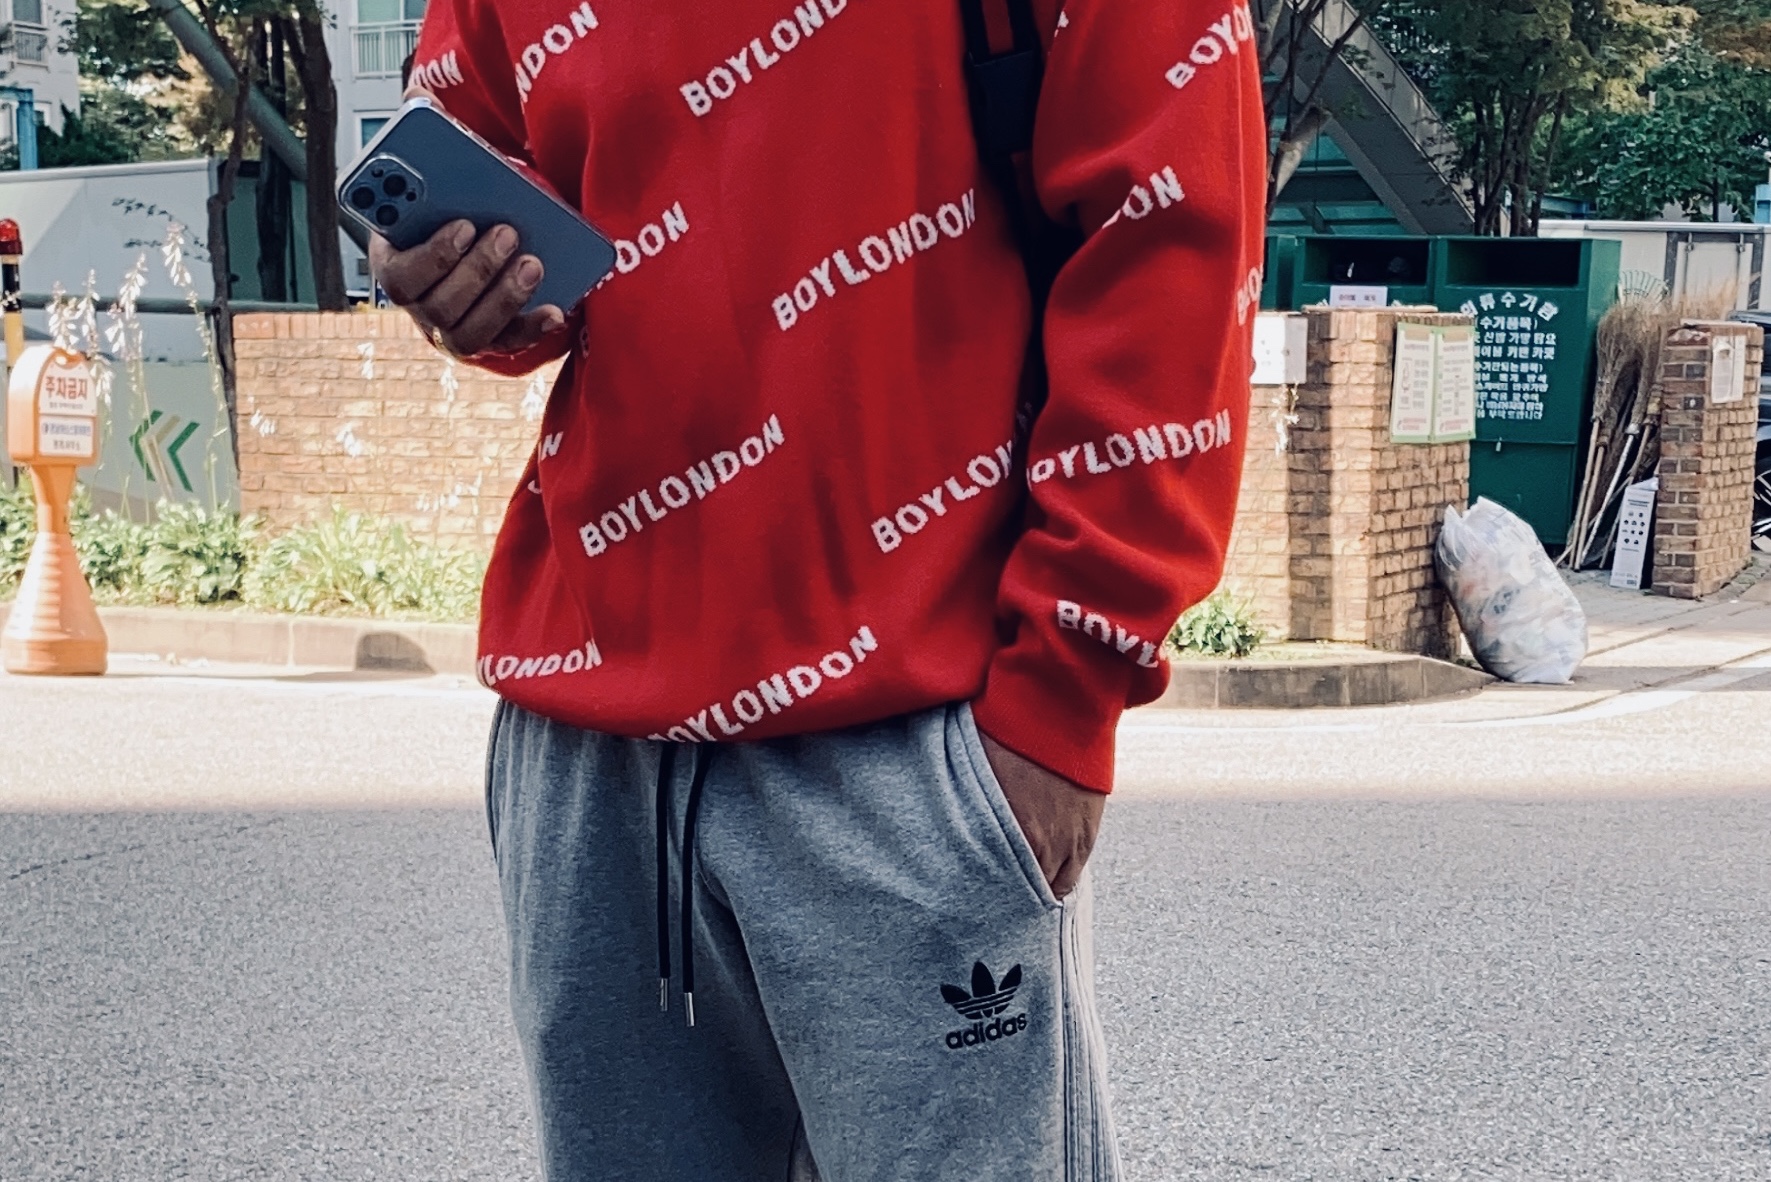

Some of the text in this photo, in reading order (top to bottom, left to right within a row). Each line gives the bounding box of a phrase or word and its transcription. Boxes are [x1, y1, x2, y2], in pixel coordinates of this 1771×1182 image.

[1102, 165, 1185, 229] ON
[597, 201, 689, 288] DON
[771, 188, 986, 331] BOYLONDON
[45, 376, 88, 400] 주차금지
[579, 413, 785, 558] BOYLONDON
[1026, 408, 1232, 492] OYLONDON
[1057, 599, 1166, 668] BOYL
[945, 1013, 1028, 1050] adidas
